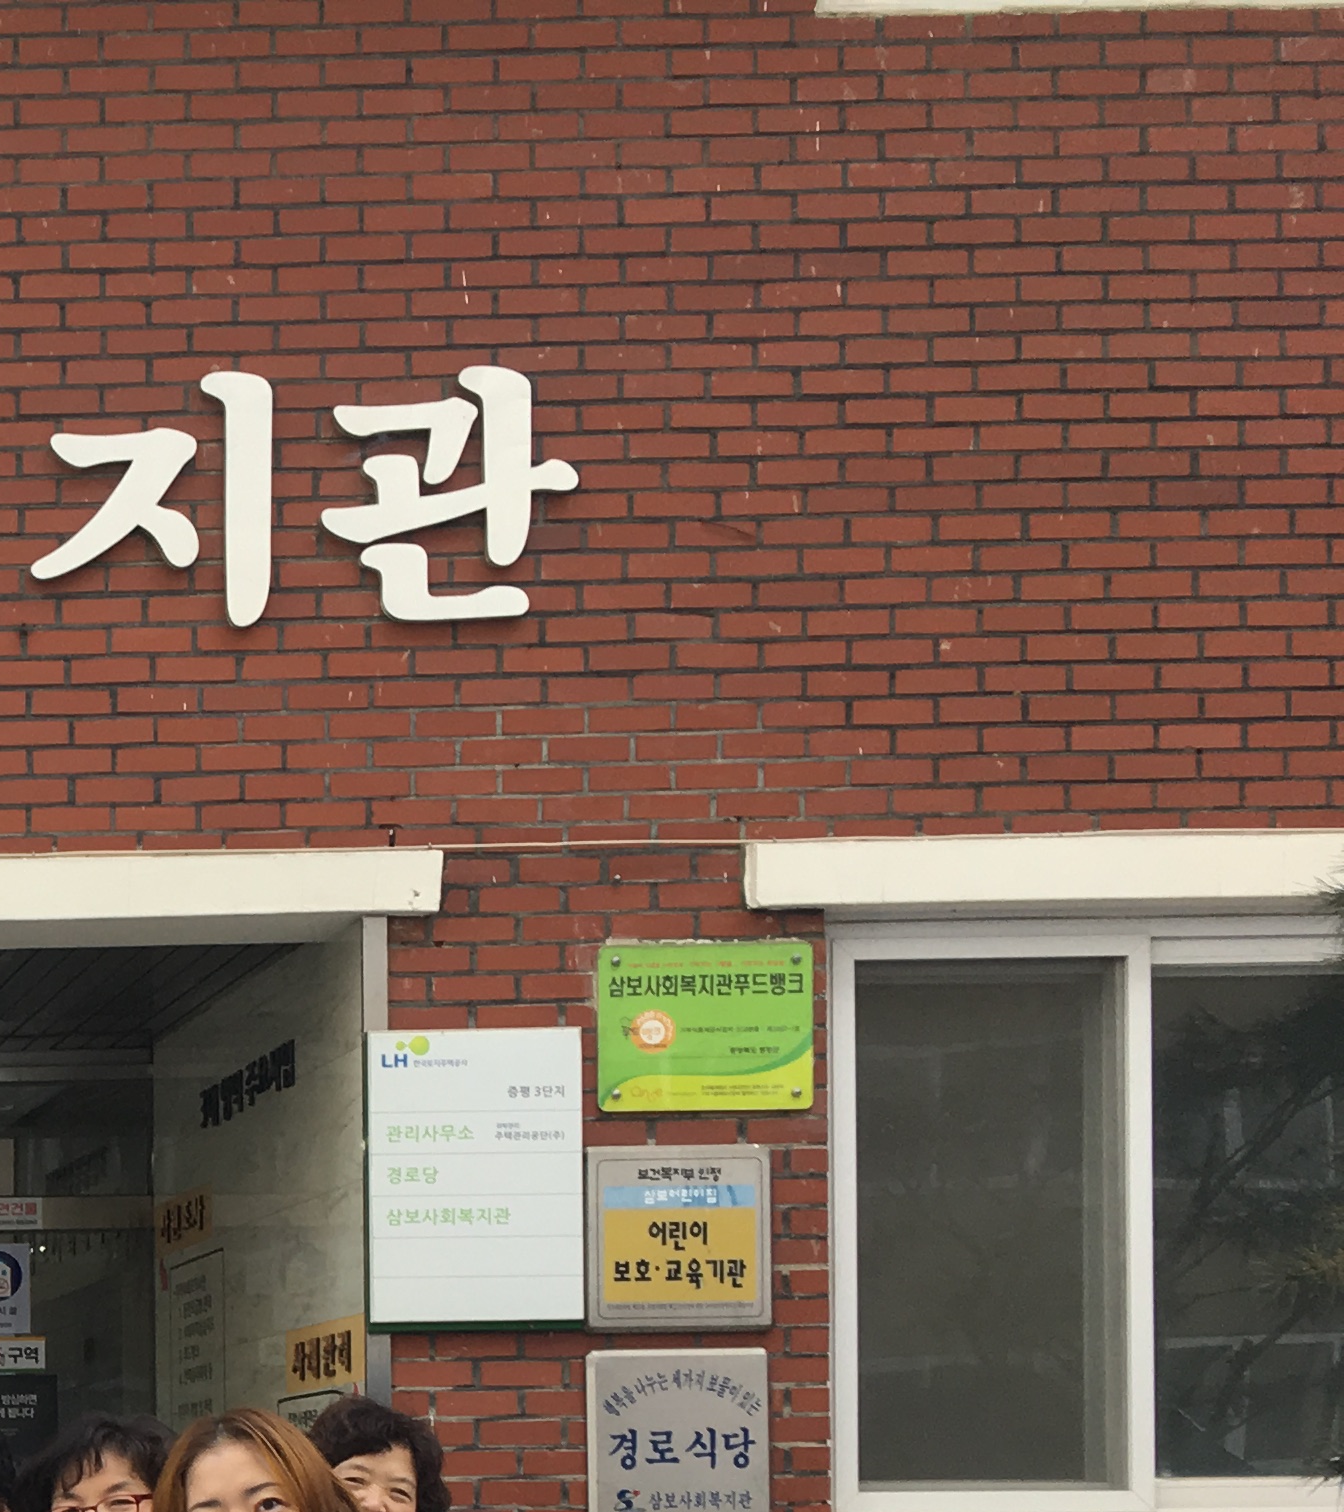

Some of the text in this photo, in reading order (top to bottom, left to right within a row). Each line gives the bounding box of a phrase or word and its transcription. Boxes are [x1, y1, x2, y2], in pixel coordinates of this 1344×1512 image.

[608, 972, 804, 998] 삼보사회복지관푸드뱅크
[381, 1054, 468, 1068] LH 한국토지주택공사
[507, 1085, 565, 1098] 증평 3단지
[386, 1125, 565, 1143] 관리사무소 주택관리공단(주)
[386, 1166, 439, 1185] 경로당
[638, 1167, 722, 1182] 보건복지부 인정
[644, 1188, 717, 1205] 삼보어린이집
[386, 1207, 511, 1228] 삼보사회복지관
[648, 1221, 708, 1251] 어린이
[8, 1347, 39, 1364] 구역
[634, 1372, 668, 1397] 나누는
[650, 1490, 752, 1511] 삼보사회복지관
